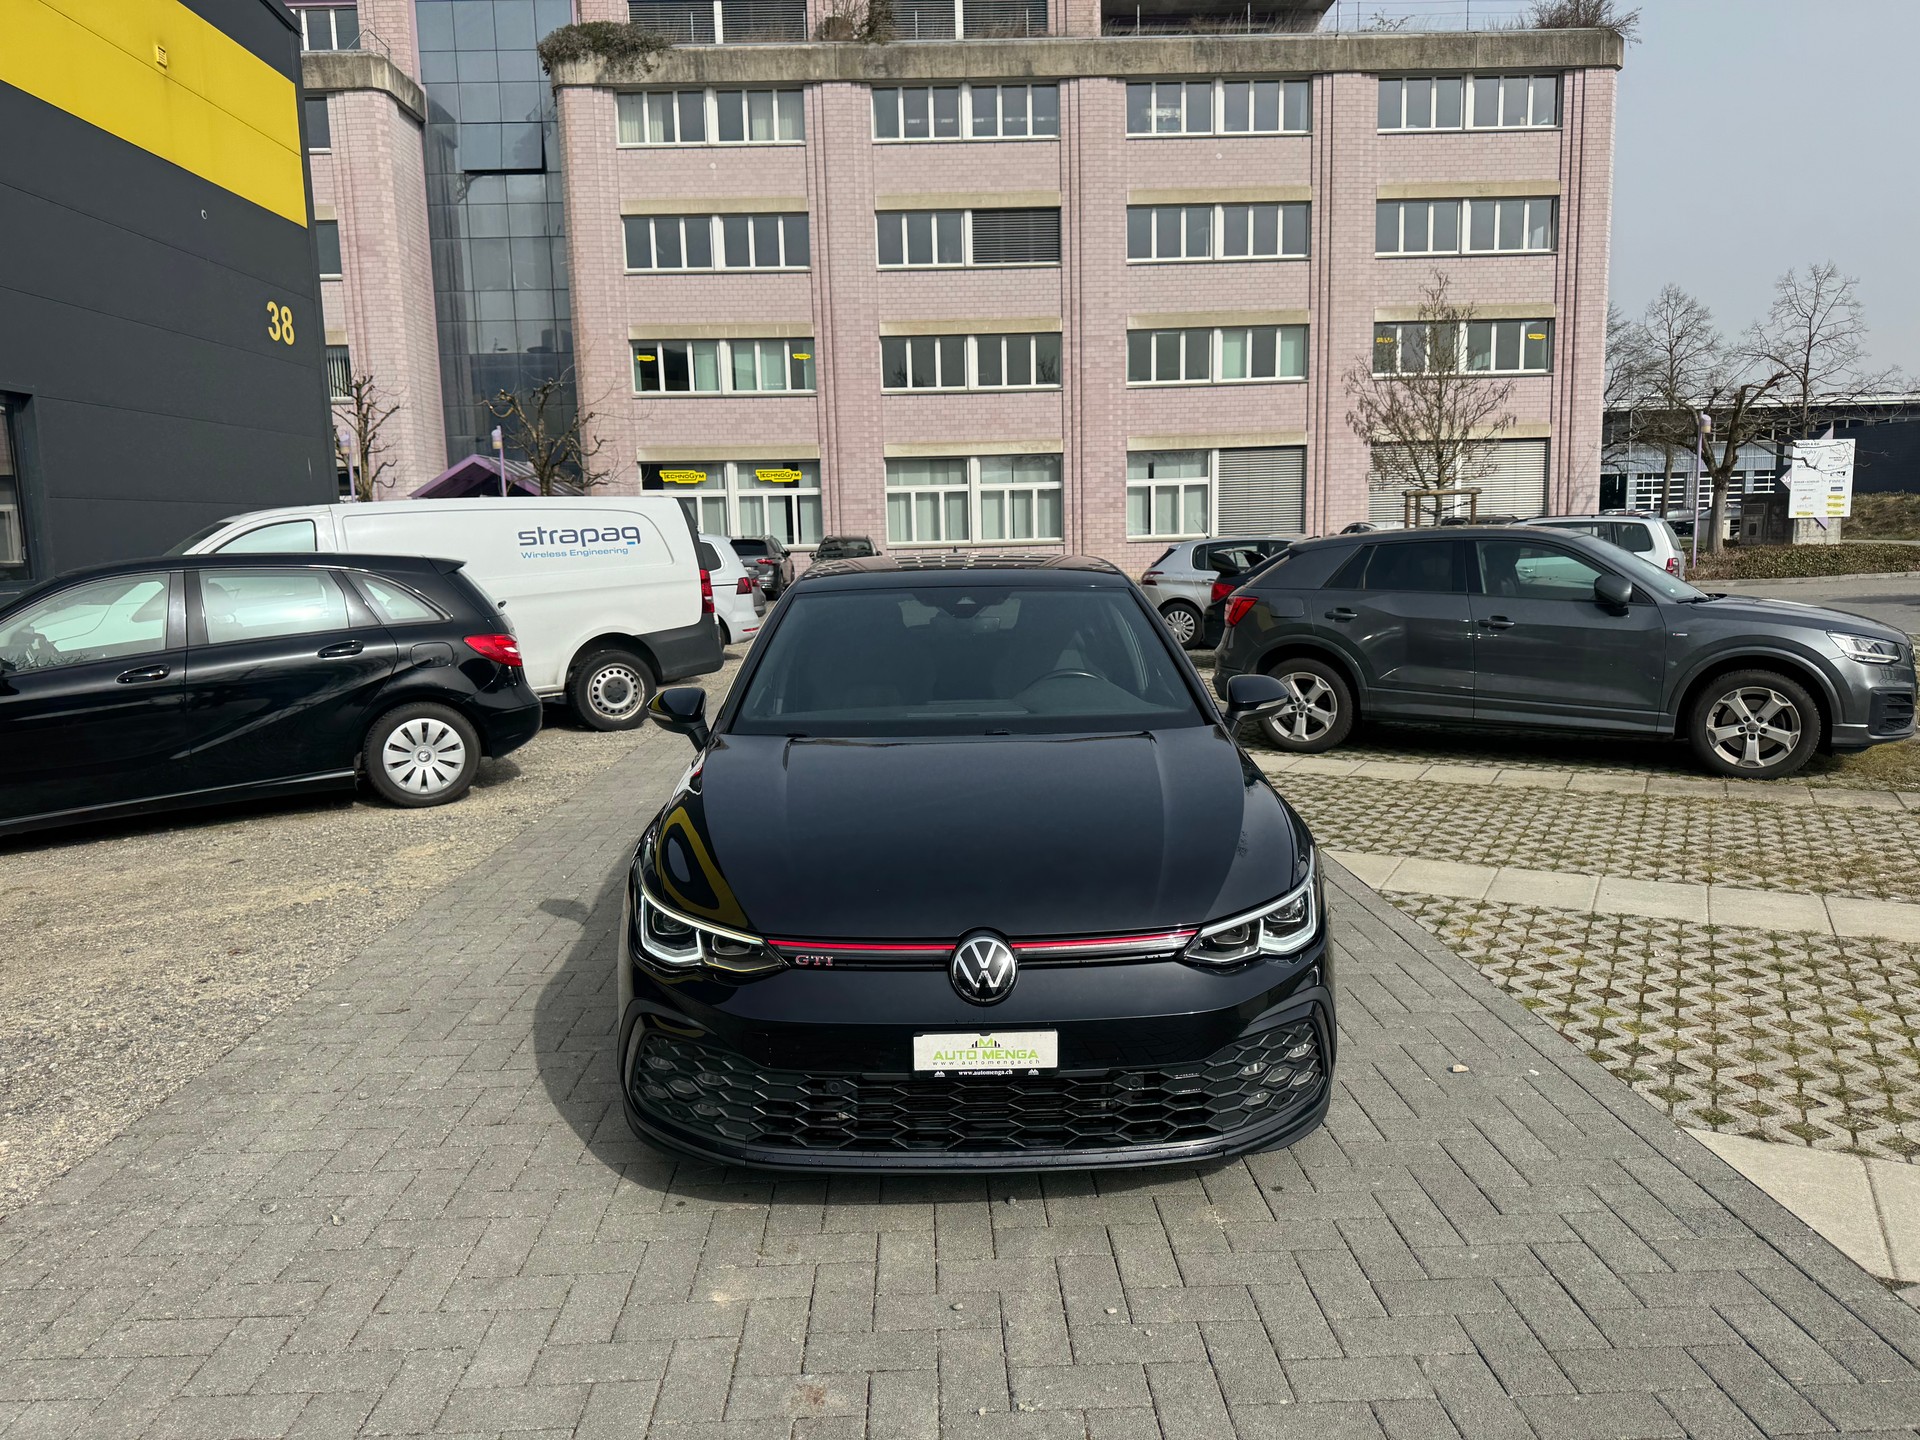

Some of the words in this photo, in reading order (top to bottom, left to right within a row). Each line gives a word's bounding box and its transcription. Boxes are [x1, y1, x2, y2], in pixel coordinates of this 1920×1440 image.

[267, 301, 295, 345] 38
[518, 526, 641, 547] strapag
[521, 550, 567, 559] Wireless
[569, 547, 629, 557] Engineering
[795, 955, 833, 966] GTI
[933, 1050, 977, 1060] AUTO
[981, 1049, 1039, 1059] MENGA
